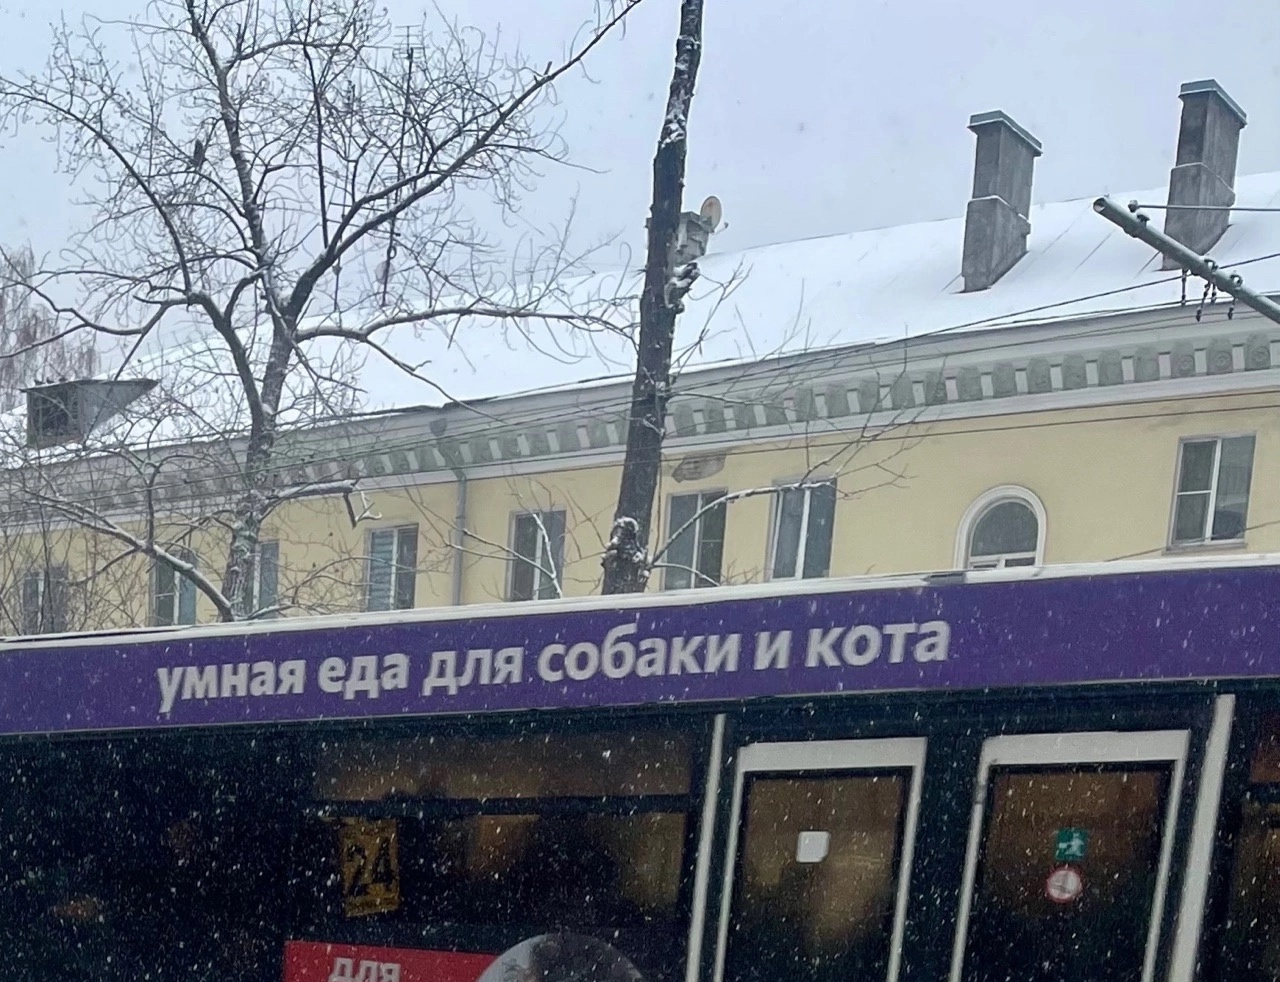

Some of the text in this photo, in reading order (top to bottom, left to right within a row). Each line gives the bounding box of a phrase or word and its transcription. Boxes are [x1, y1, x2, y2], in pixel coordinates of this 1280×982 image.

[156, 619, 951, 713] умная еда для собаки и кота
[347, 837, 395, 897] 24
